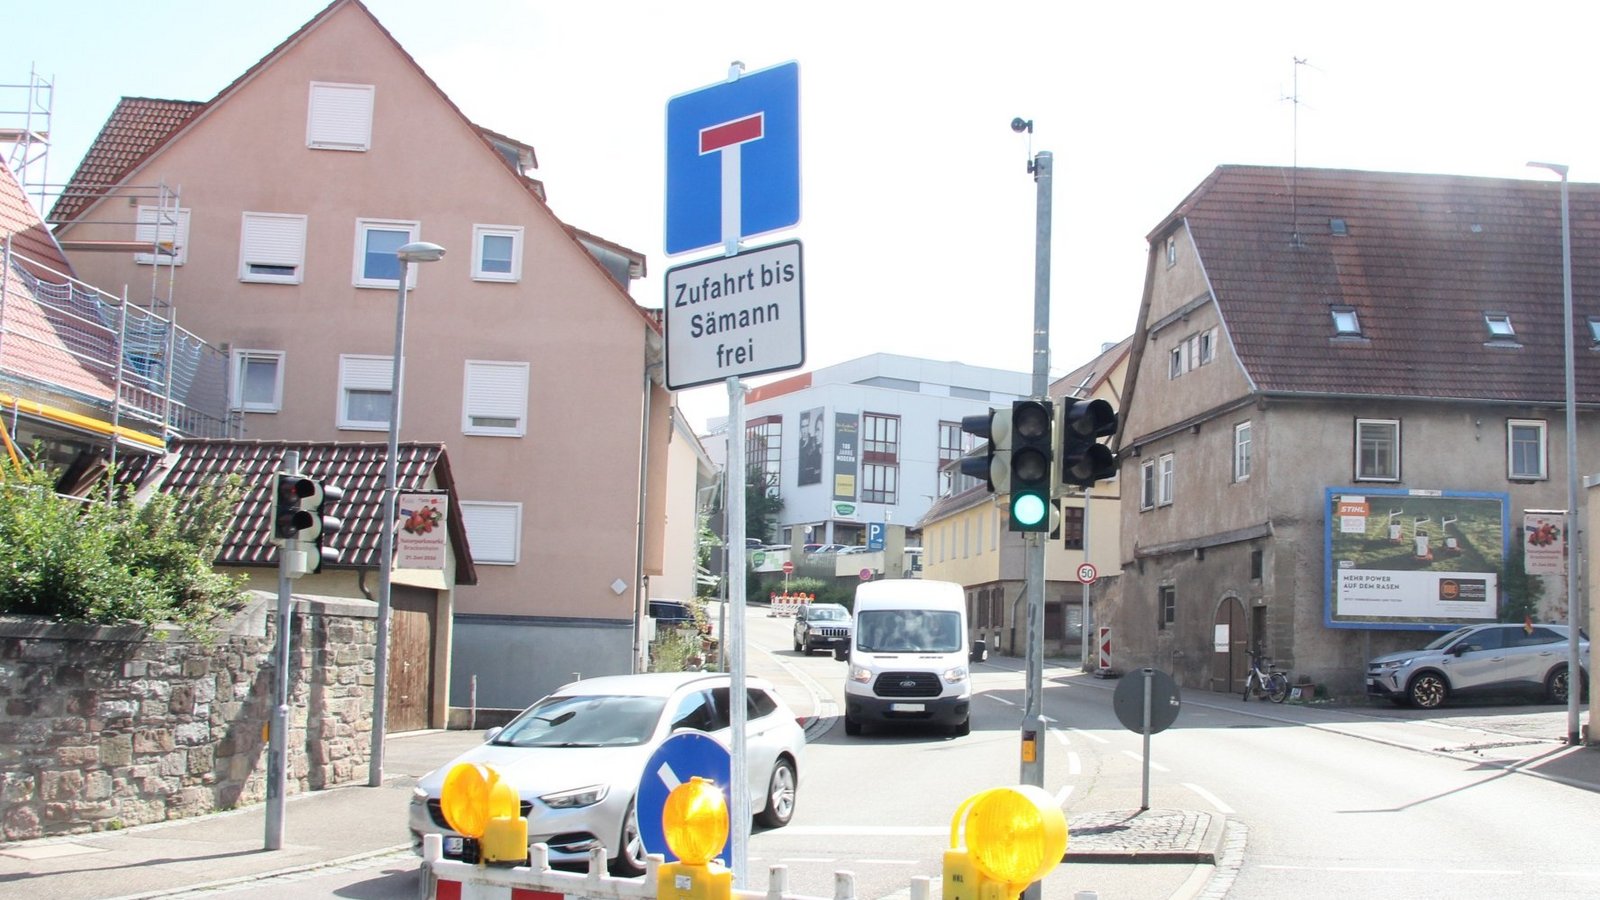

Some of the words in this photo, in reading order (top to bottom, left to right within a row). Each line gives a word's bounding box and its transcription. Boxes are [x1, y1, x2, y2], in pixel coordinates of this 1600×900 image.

[675, 268, 754, 308] Zufahrt
[761, 260, 795, 287] bis
[690, 302, 779, 338] Sämann
[716, 338, 753, 368] frei
[1340, 505, 1365, 513] STIHL
[870, 524, 881, 541] P
[1081, 568, 1093, 579] 50
